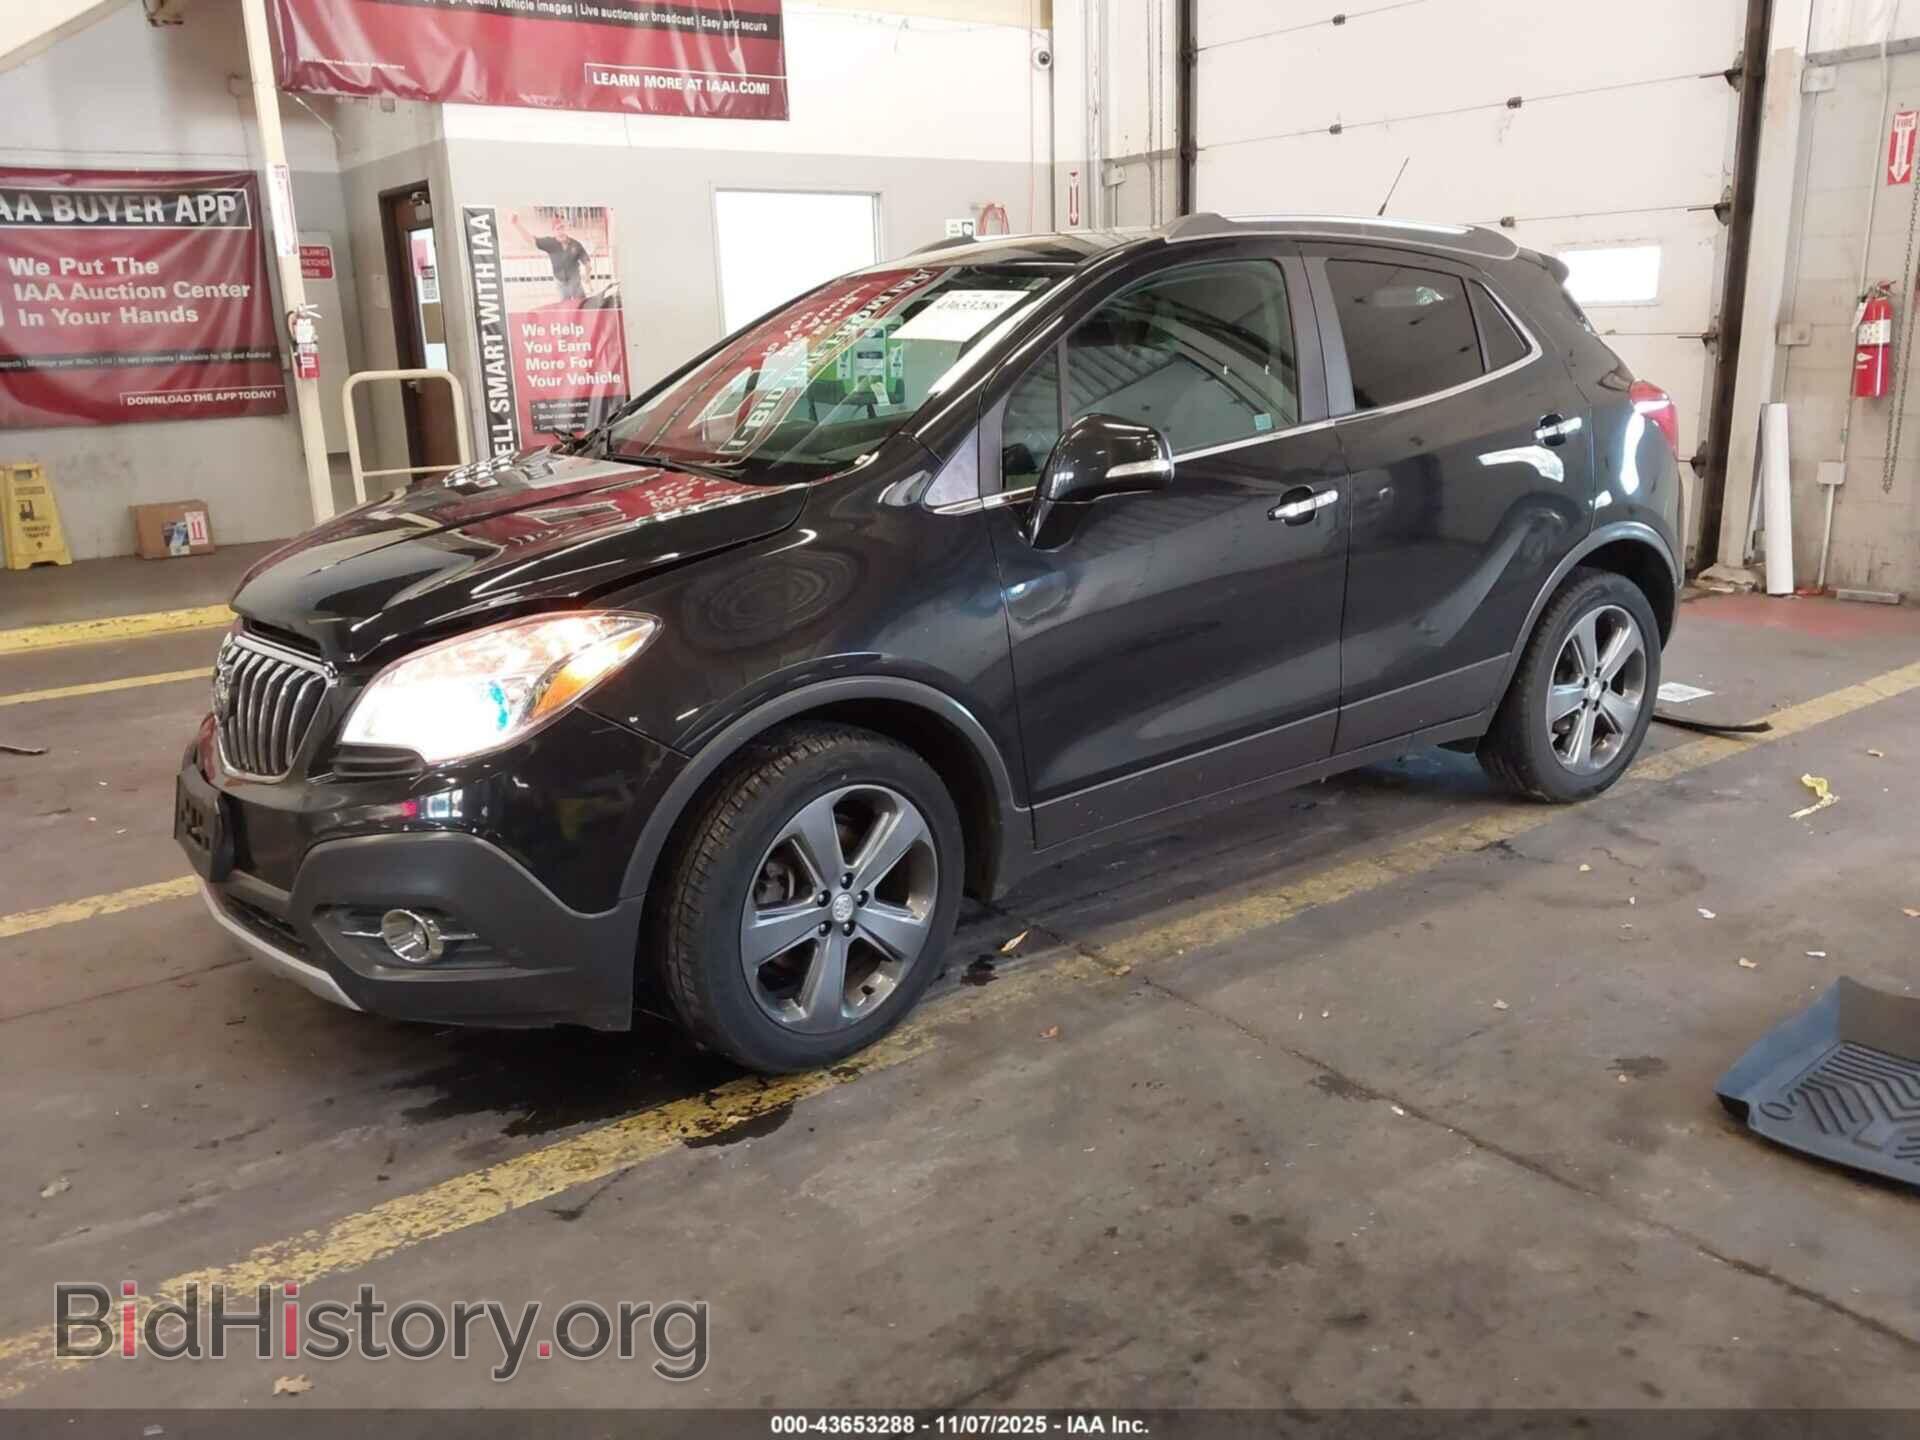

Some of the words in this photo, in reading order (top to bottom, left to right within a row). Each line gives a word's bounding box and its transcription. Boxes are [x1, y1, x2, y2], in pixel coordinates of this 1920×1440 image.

[501, 0, 534, 11] vehicle
[537, 2, 572, 15] images
[581, 4, 599, 16] Live
[601, 8, 649, 21] auctioneer
[652, 12, 694, 25] broadcast
[702, 16, 720, 30] Easy
[723, 17, 739, 29] and
[741, 20, 767, 31] secure
[593, 72, 640, 87] LEARN
[644, 76, 682, 90] MORE
[687, 79, 703, 91] AT
[707, 80, 770, 95] IAAI.COM!
[51, 194, 165, 222] BUYER
[174, 195, 236, 223] APP
[471, 213, 494, 255] IAA
[8, 257, 50, 276] We
[59, 257, 104, 276] Put
[111, 256, 159, 275] The
[13, 283, 62, 301] IAA
[69, 282, 166, 301] Auction
[173, 280, 251, 299] Center
[474, 263, 502, 325] WITH
[18, 308, 44, 327] In
[51, 307, 111, 326] Your
[120, 305, 199, 324] Hands
[522, 323, 545, 337] We
[550, 322, 584, 338] Help
[524, 341, 552, 353] You
[557, 340, 592, 352] Earn
[483, 332, 510, 412] SMART
[526, 358, 565, 370] More
[570, 356, 593, 369] For
[527, 374, 562, 387] Your
[566, 371, 621, 385] Vehicle
[127, 394, 192, 406] DOWNLOAD
[193, 393, 213, 403] THE
[215, 391, 237, 402] APP
[238, 390, 277, 400] TODAY!
[493, 418, 515, 457] ELL
